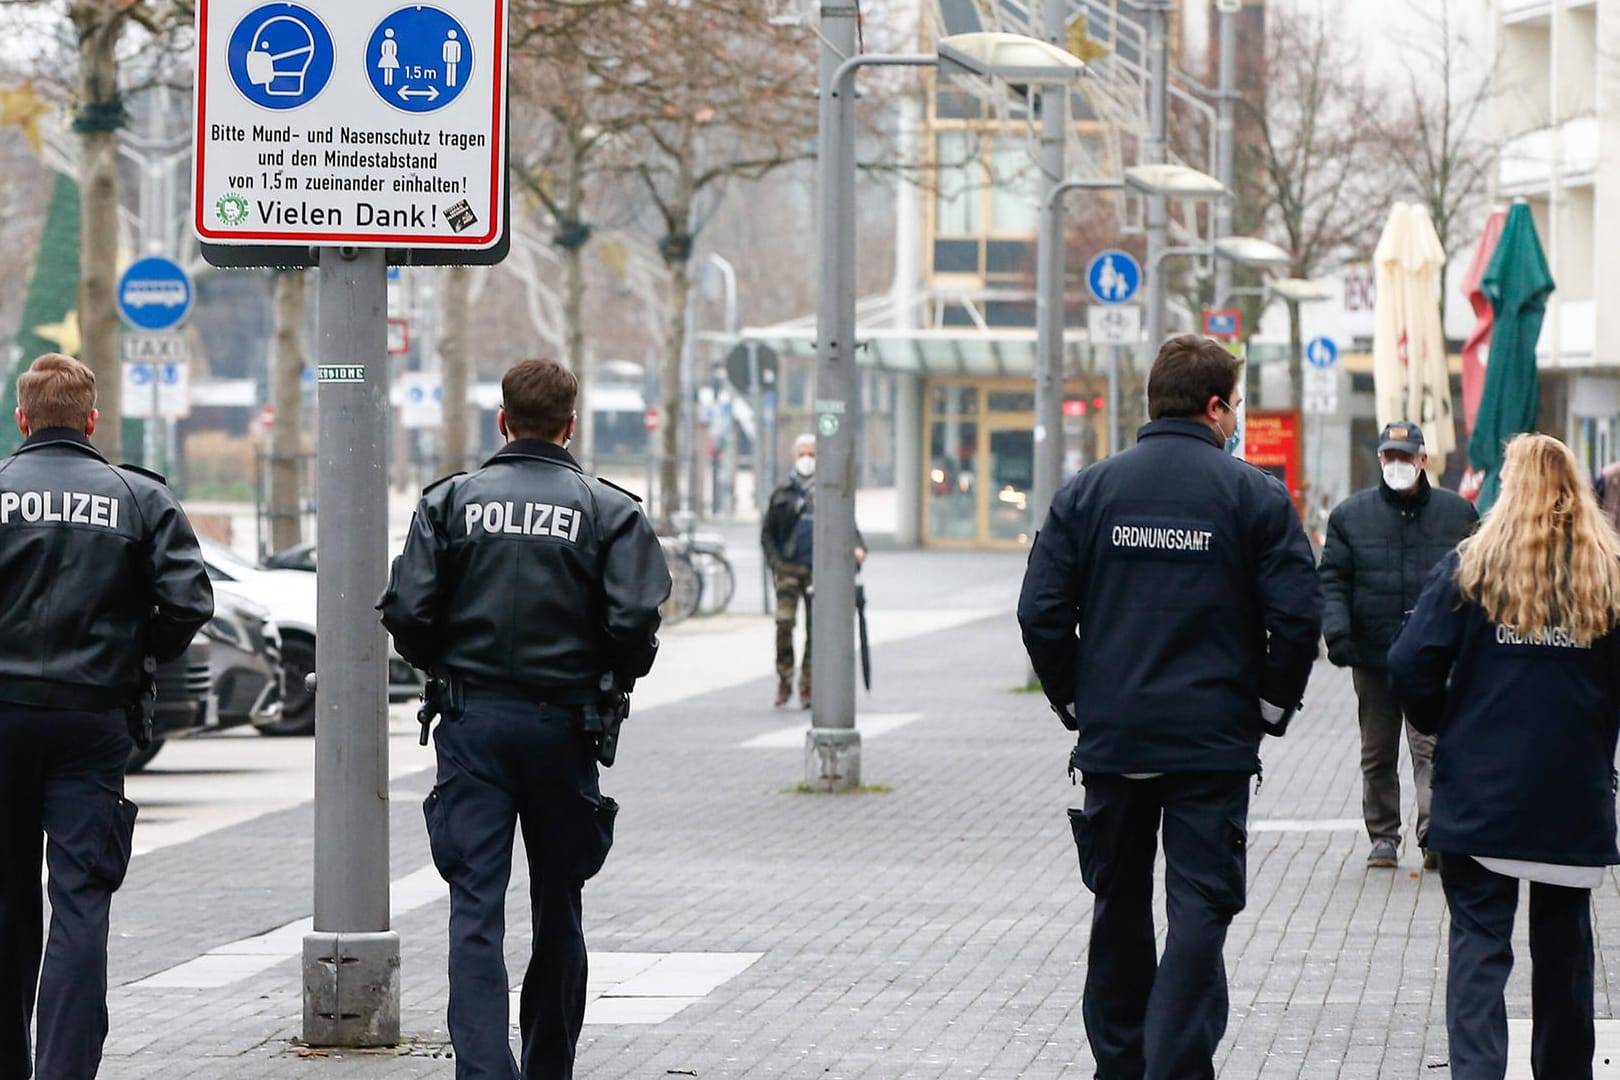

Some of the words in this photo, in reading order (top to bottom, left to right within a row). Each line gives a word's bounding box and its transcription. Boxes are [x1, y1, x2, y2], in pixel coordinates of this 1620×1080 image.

[211, 124, 245, 142] Bitte
[252, 125, 300, 144] Mund-
[308, 126, 333, 144] und
[340, 127, 431, 146] Nasenschutz
[438, 130, 485, 151] tragen
[258, 150, 284, 166] und
[291, 150, 317, 167] den
[324, 150, 438, 169] Mindestabstand
[228, 175, 254, 189] von
[305, 175, 385, 192] zueinander
[392, 175, 467, 194] einhalten!
[257, 200, 342, 226] Vielen
[356, 202, 437, 228] Dank!
[0, 490, 119, 529] POLIZEI
[465, 501, 582, 543] POLIZEI
[1112, 525, 1213, 551] ORDNUNGSAMT
